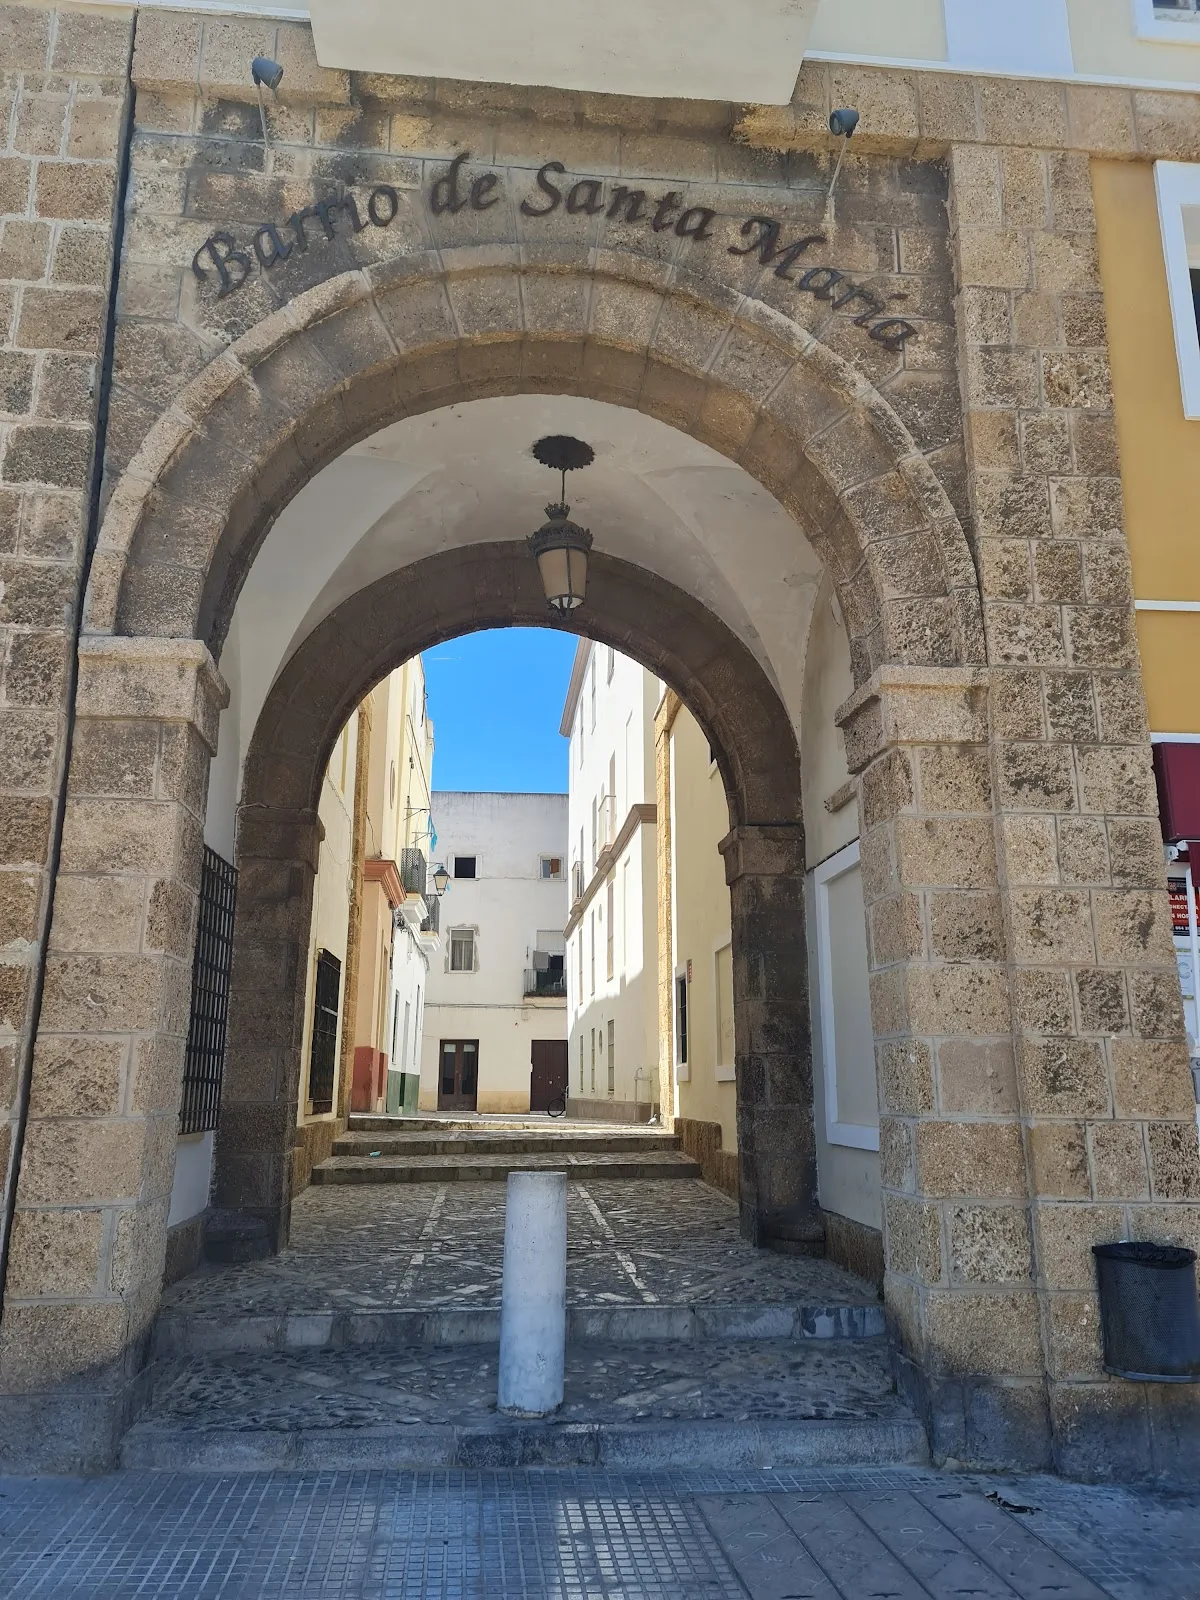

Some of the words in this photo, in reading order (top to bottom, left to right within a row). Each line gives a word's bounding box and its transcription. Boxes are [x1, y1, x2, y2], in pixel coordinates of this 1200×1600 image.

[193, 184, 398, 299] Barrio
[430, 152, 500, 215] de
[520, 161, 717, 241] Santa
[727, 216, 918, 351] María
